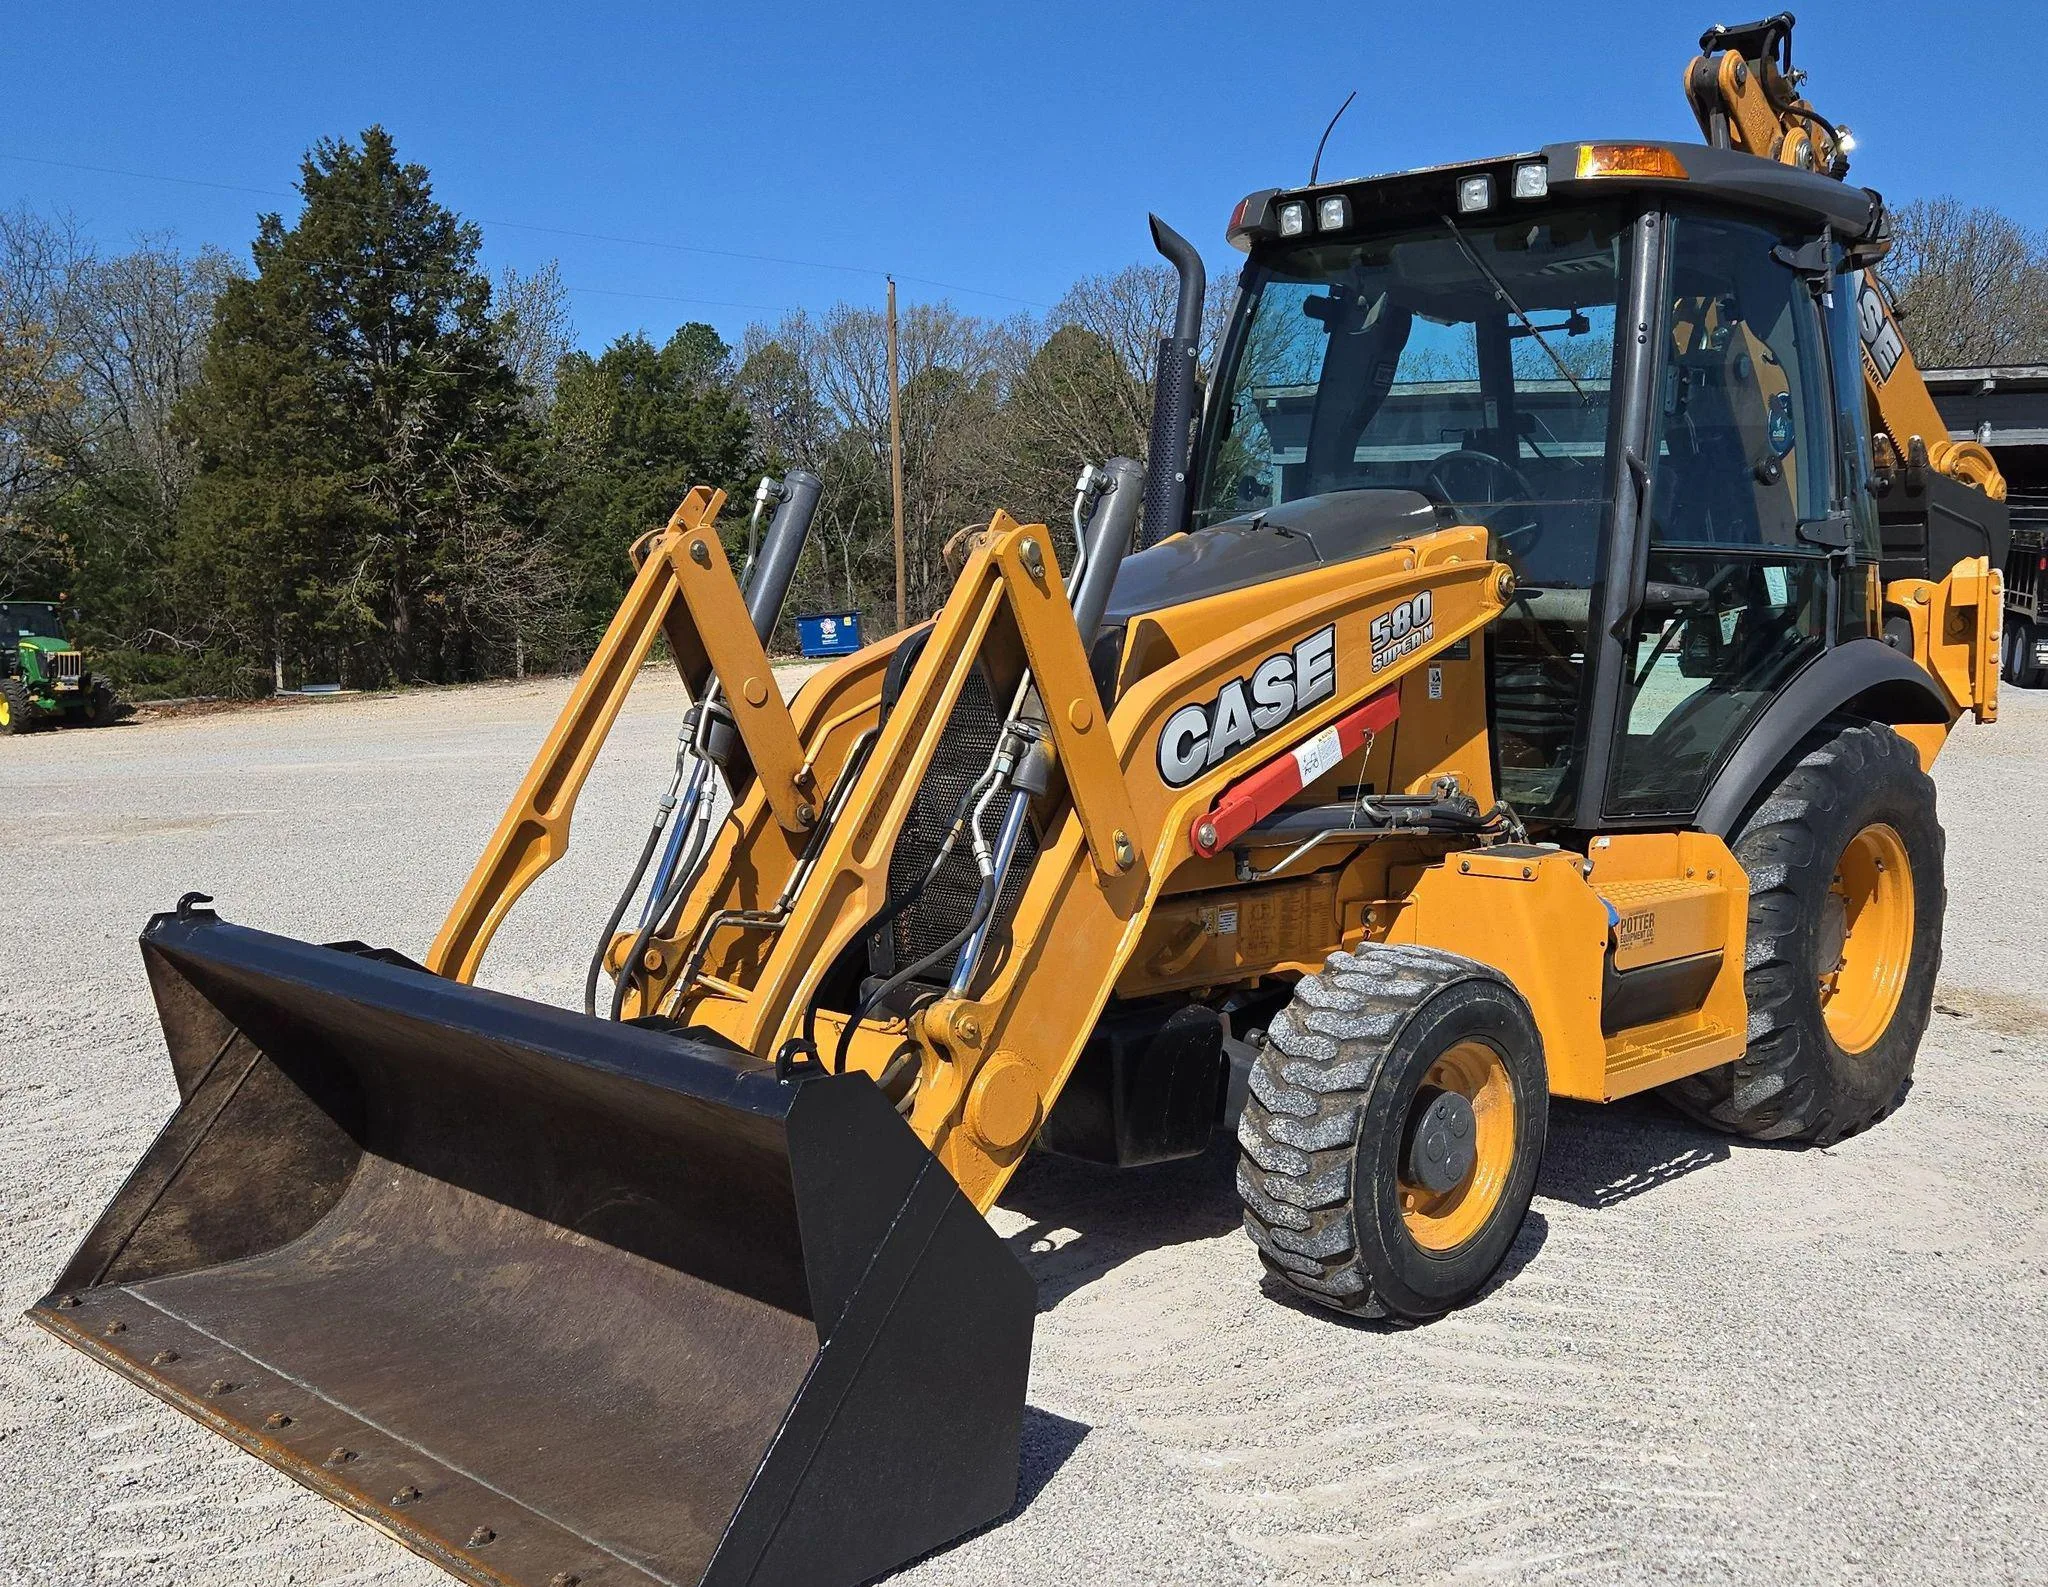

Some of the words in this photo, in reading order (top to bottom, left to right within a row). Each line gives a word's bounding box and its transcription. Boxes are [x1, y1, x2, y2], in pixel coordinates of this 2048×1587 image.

[1857, 270, 1903, 383] SE
[1370, 590, 1432, 653] 580
[1372, 630, 1421, 673] SUPER
[1423, 621, 1434, 643] N
[1158, 624, 1335, 786] CASE
[1620, 912, 1655, 934] POTTER
